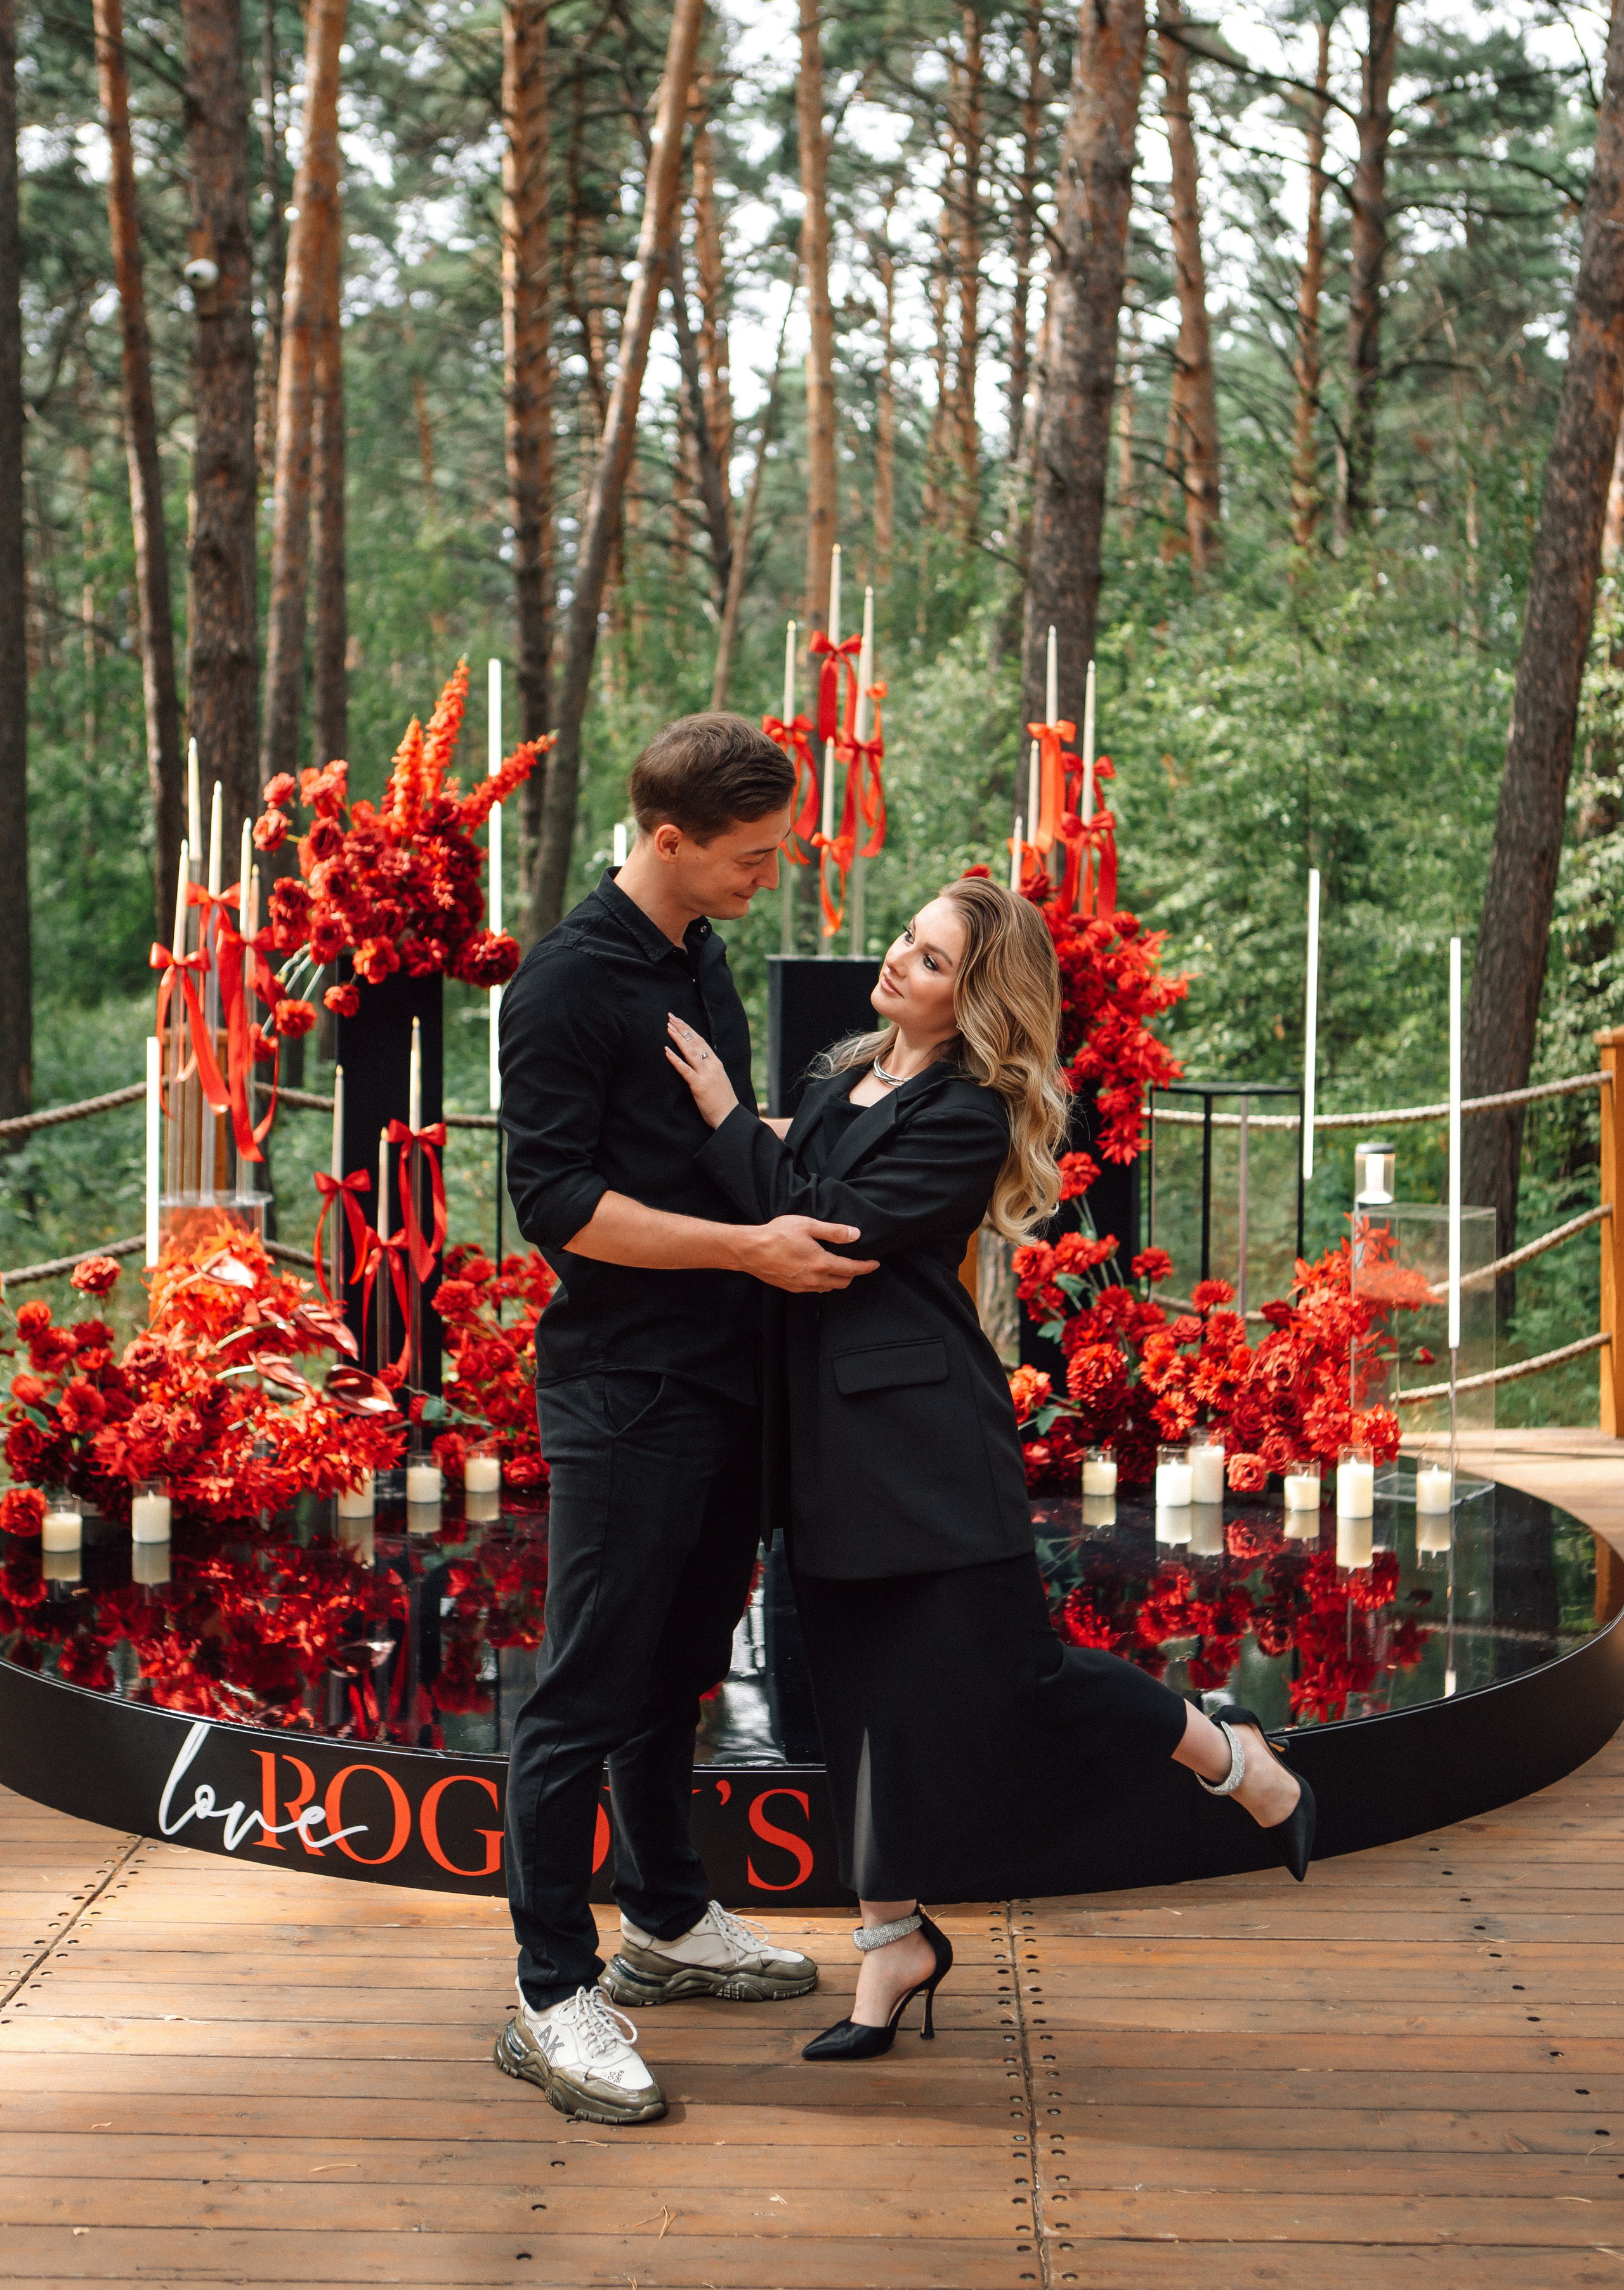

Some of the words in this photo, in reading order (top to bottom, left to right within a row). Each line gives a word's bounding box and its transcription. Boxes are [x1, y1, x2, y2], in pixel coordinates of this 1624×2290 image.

[159, 1722, 369, 1851] love
[250, 1749, 814, 1891] ROG'S
[539, 2025, 565, 2062] AK
